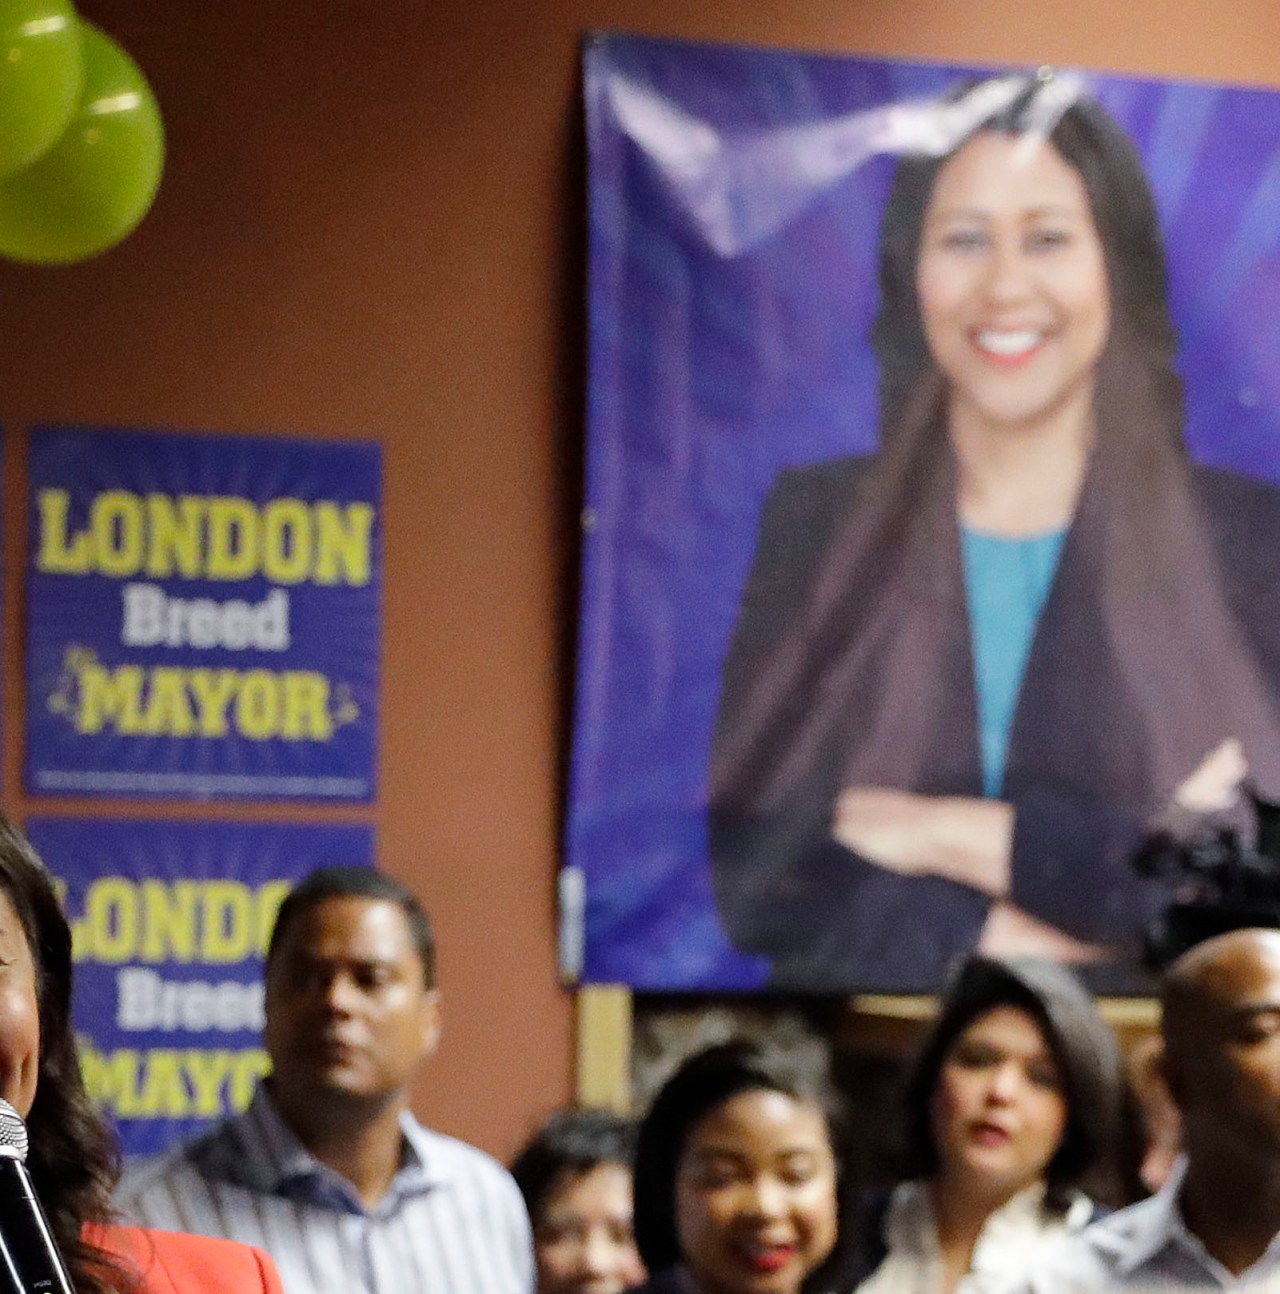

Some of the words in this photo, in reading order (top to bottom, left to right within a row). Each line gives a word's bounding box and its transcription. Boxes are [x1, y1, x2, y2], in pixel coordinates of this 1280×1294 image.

[37, 487, 376, 588] LONDON
[122, 582, 292, 652] Breed
[74, 662, 332, 742] MAYOR
